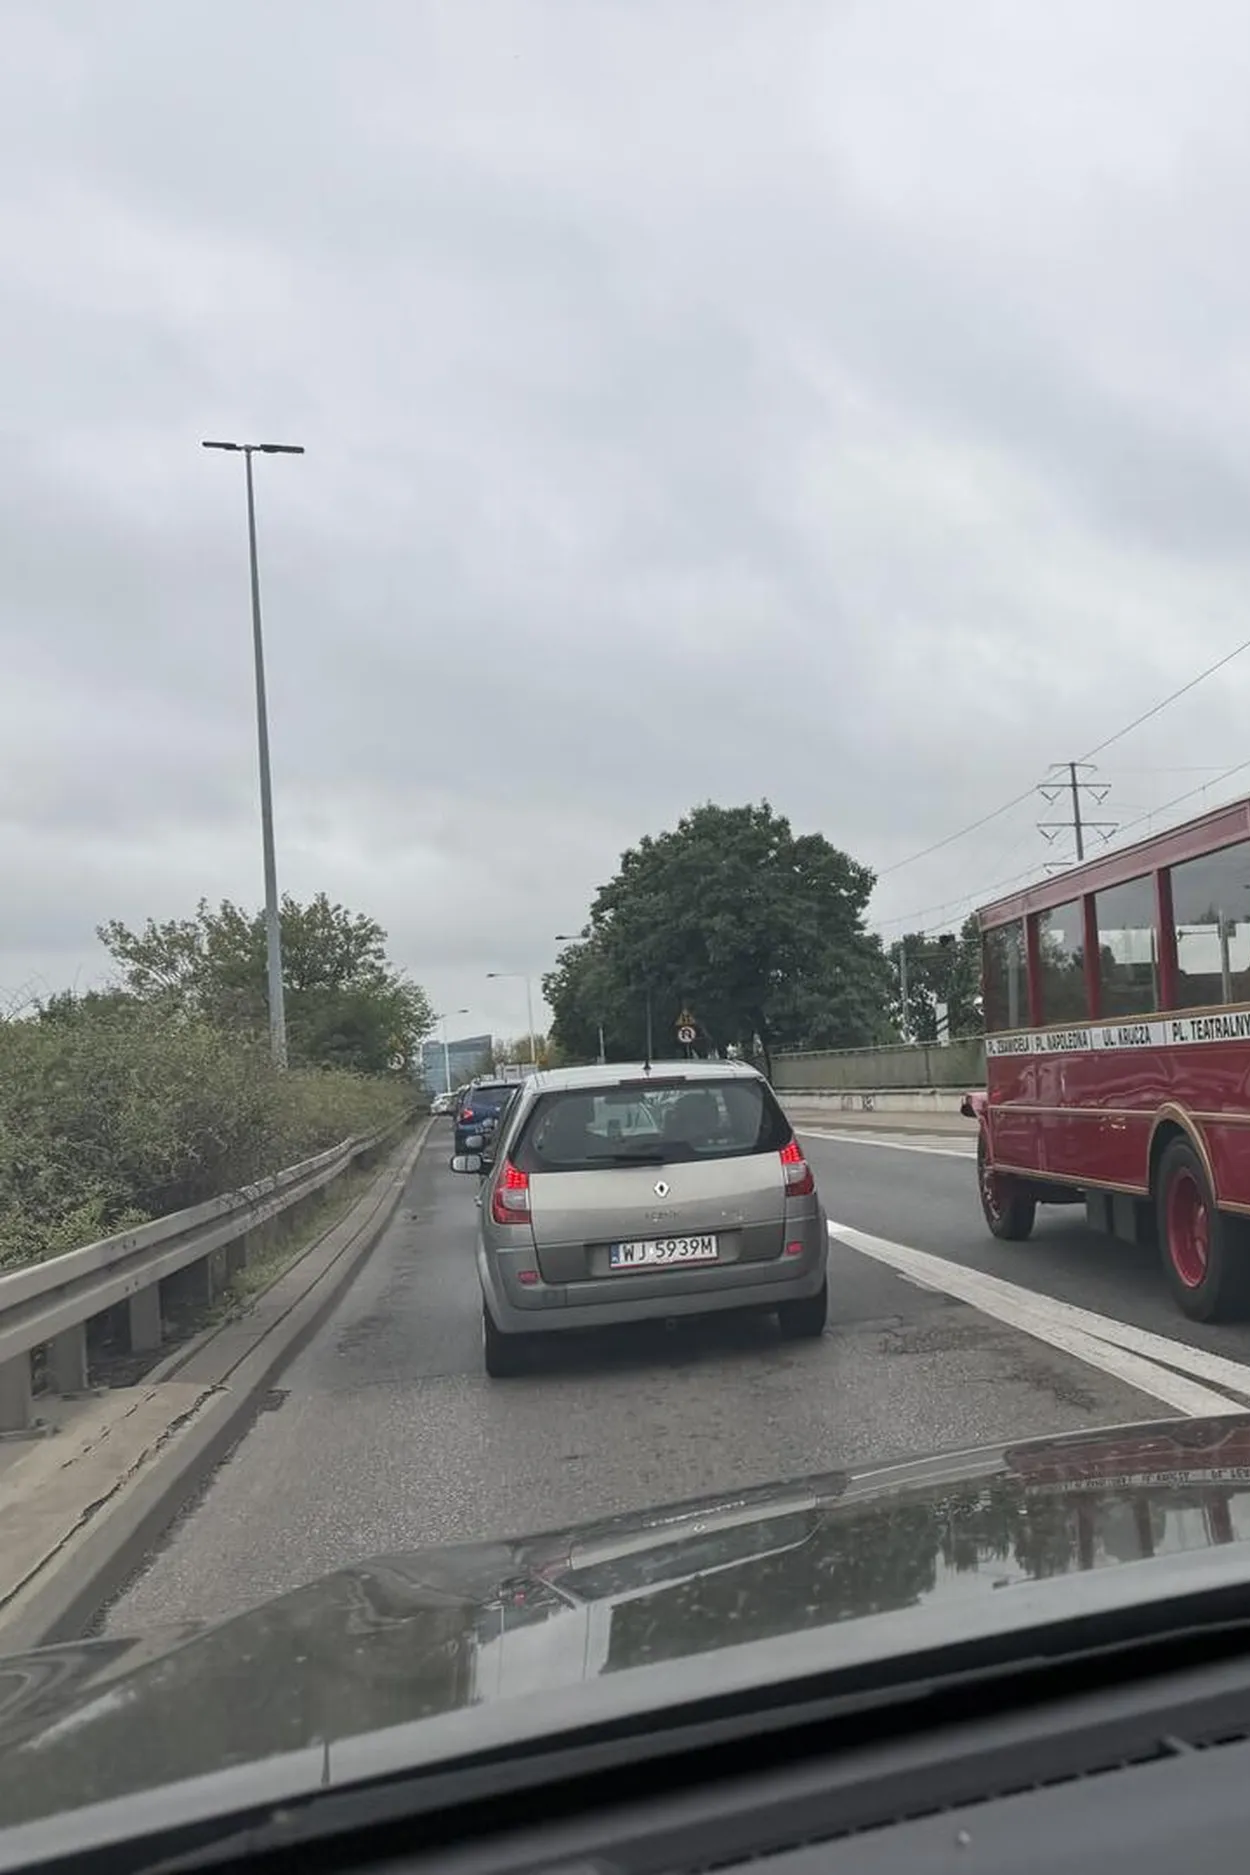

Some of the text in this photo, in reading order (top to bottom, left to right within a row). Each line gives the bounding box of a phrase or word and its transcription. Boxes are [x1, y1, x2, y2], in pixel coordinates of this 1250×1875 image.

[1119, 1026, 1152, 1045] KRUCZA
[1172, 1021, 1188, 1042] PL.
[1191, 1013, 1250, 1041] TEATRALNY
[623, 1237, 713, 1262] WJ 5939M
